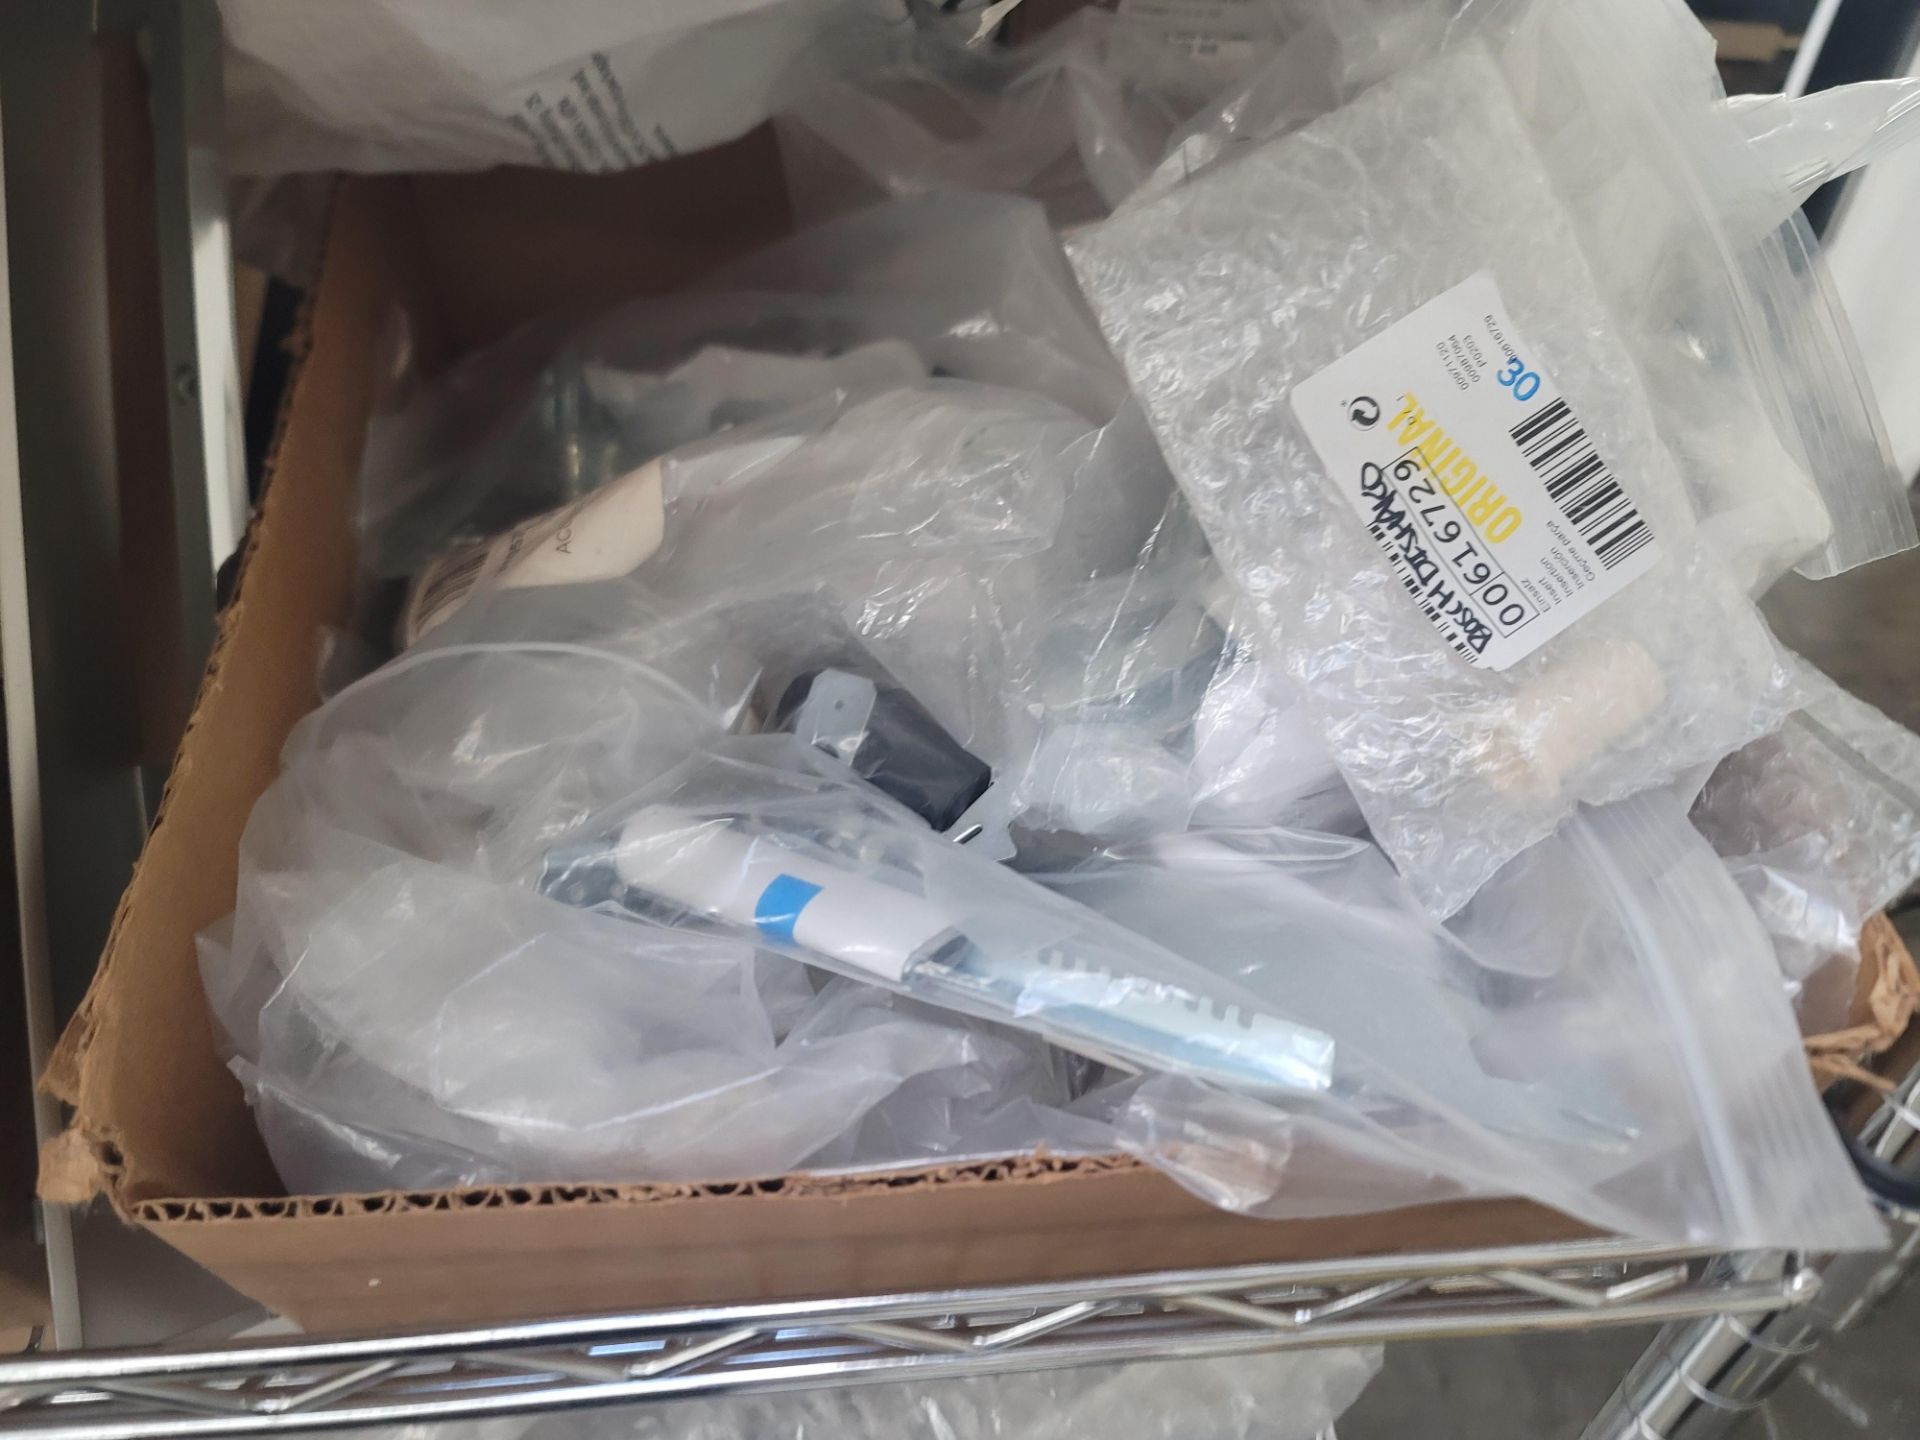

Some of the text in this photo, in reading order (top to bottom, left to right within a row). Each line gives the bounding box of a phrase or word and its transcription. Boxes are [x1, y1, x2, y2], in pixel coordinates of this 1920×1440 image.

[1496, 356, 1541, 401] 30
[1387, 391, 1523, 544] ORIGINAL
[1545, 520, 1596, 582] Geçme parça
[1550, 546, 1584, 590] Inserción
[1520, 578, 1551, 613] Einsatz
[1538, 577, 1562, 605] Insert
[1540, 557, 1574, 597] Insertion
[1427, 579, 1493, 654] BOSCH
